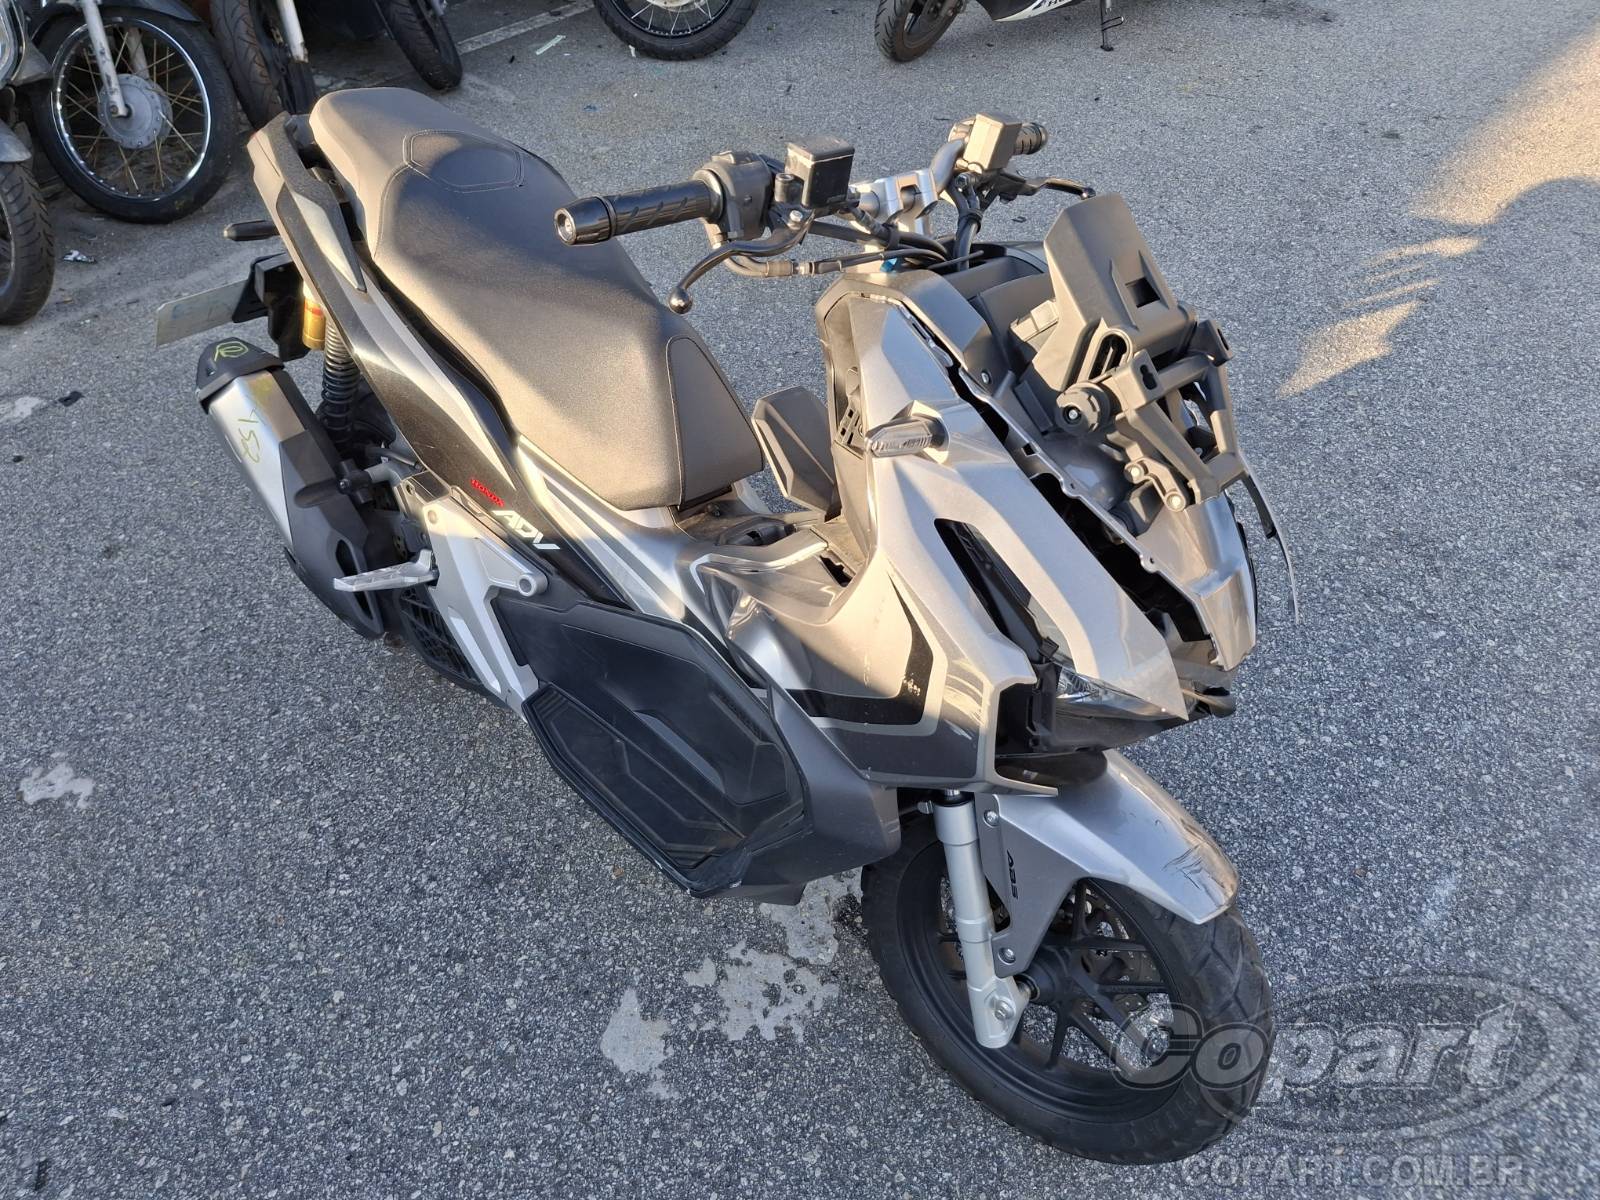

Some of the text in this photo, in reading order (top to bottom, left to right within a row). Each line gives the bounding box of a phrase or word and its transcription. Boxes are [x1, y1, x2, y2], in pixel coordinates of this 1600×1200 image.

[470, 479, 505, 508] HONDA
[492, 510, 561, 550] ADV
[1006, 849, 1019, 900] ABS
